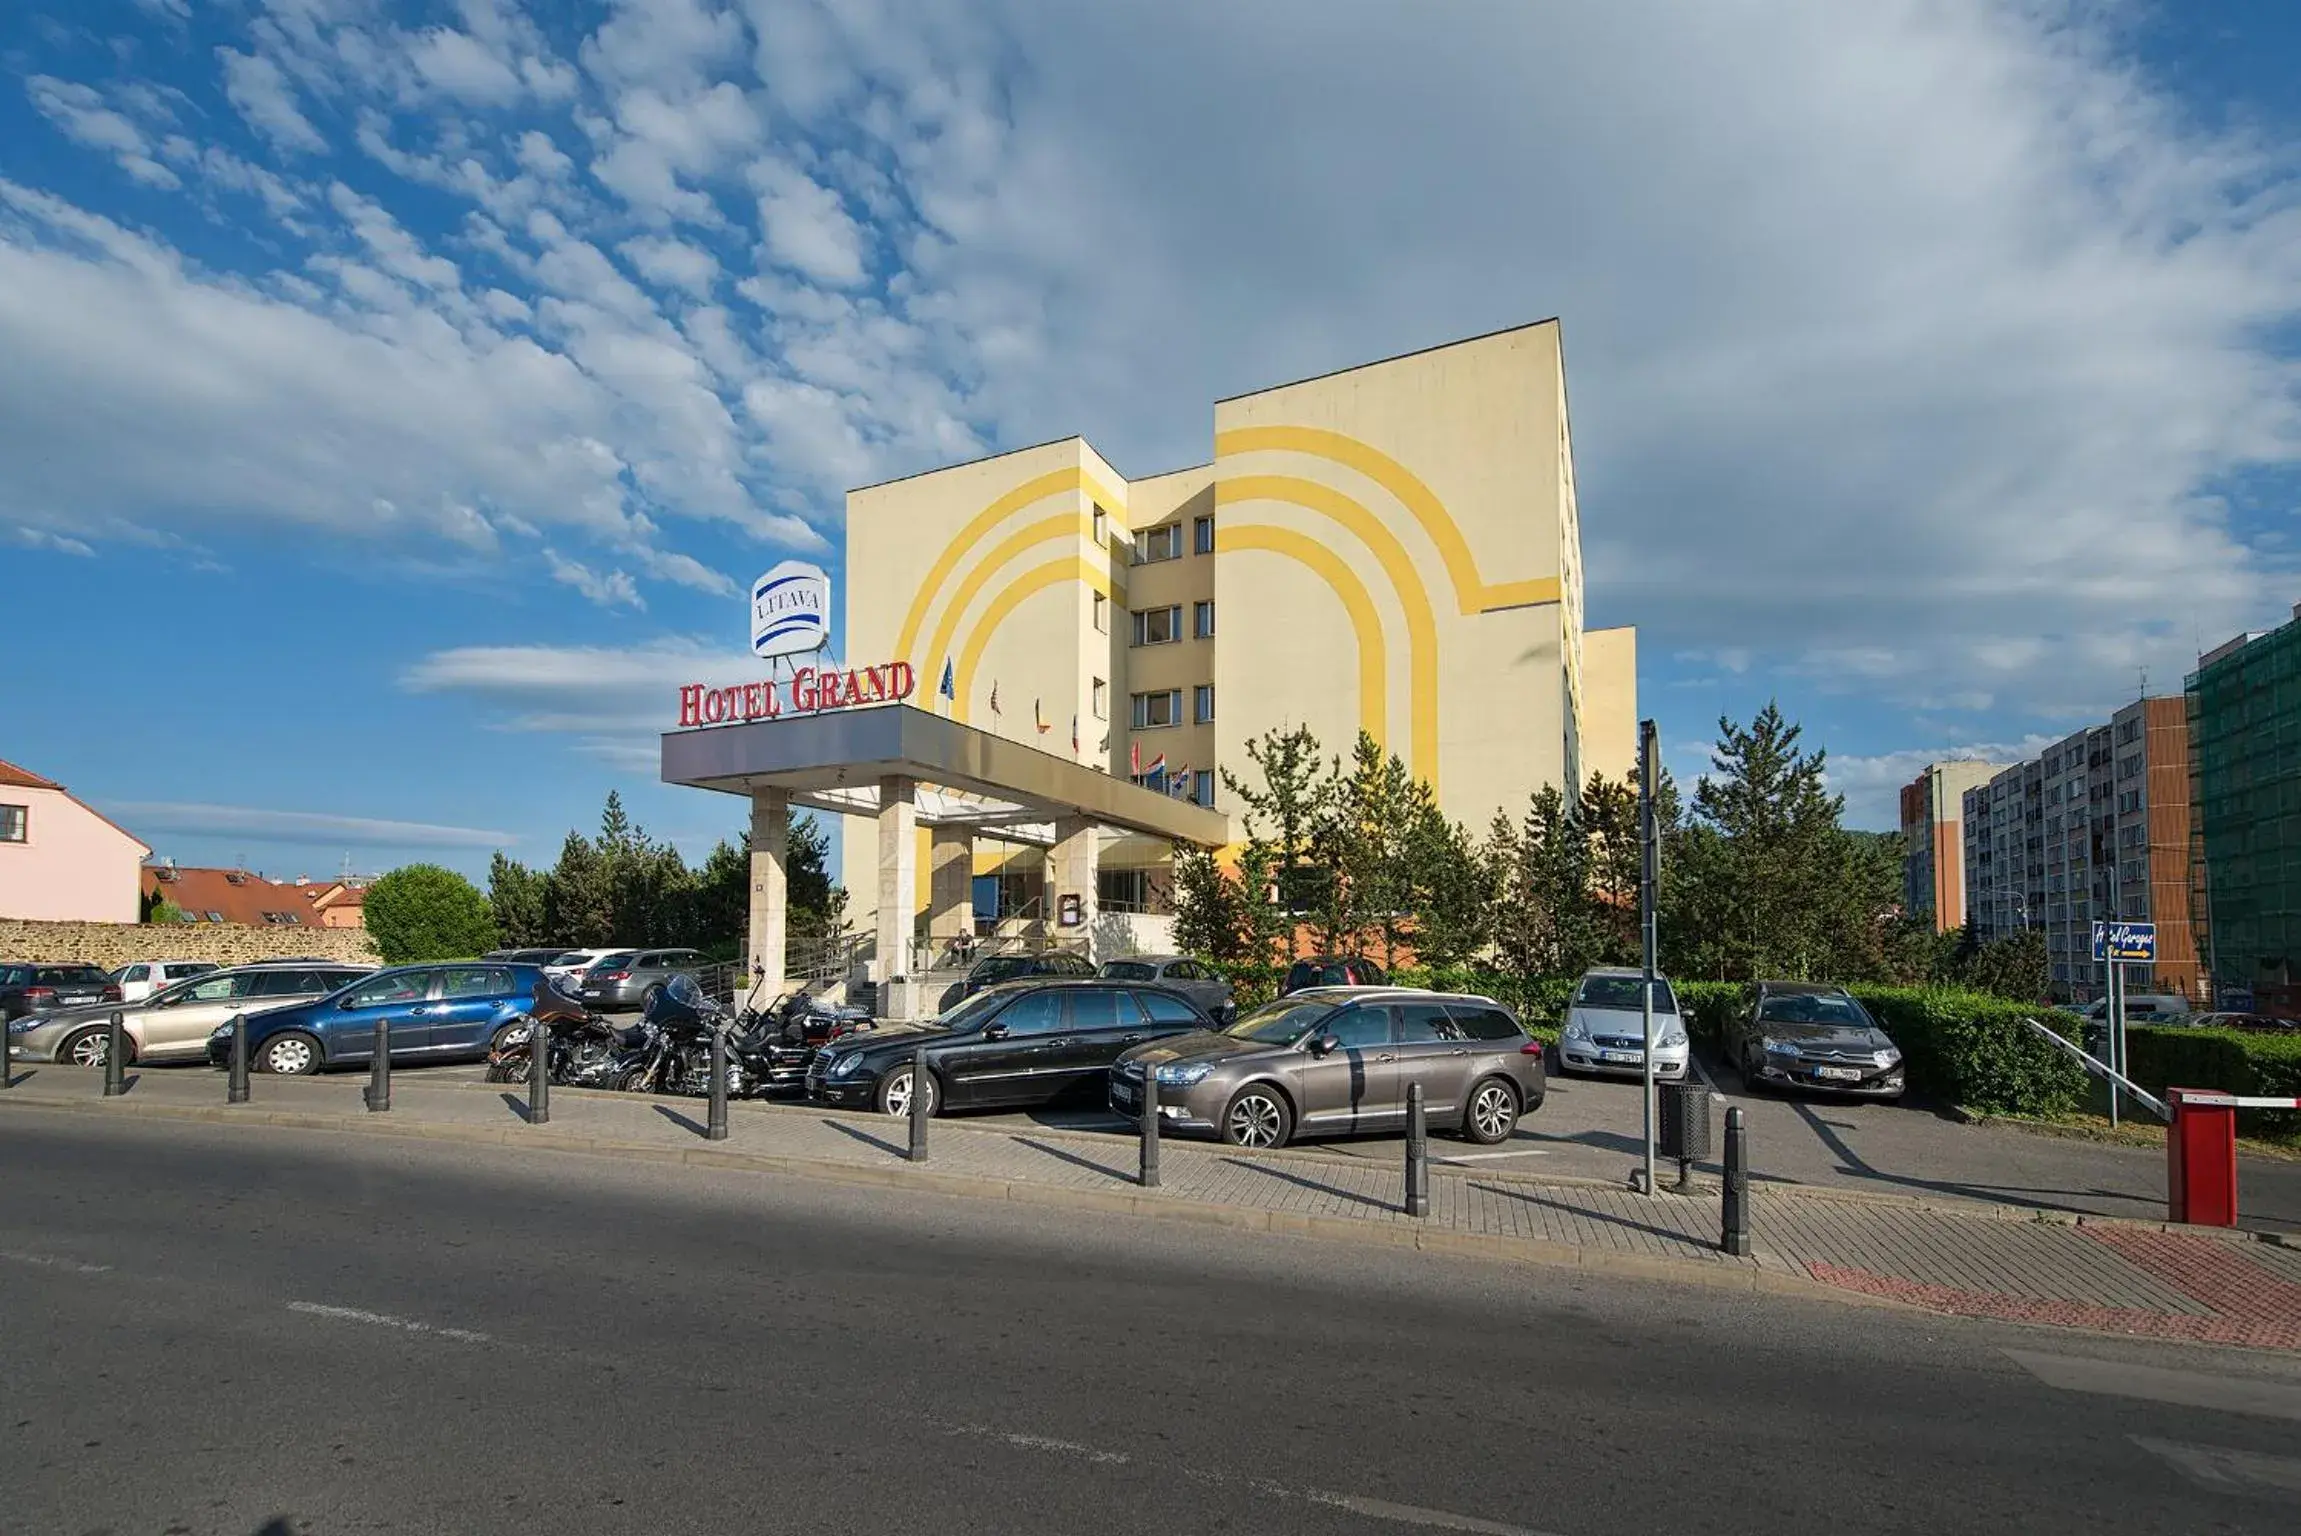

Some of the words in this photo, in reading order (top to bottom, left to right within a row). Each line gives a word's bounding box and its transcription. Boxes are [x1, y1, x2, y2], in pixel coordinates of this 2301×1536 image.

[757, 590, 819, 619] LITAVA
[679, 681, 780, 727] HOTEL
[792, 661, 914, 712] GRAND
